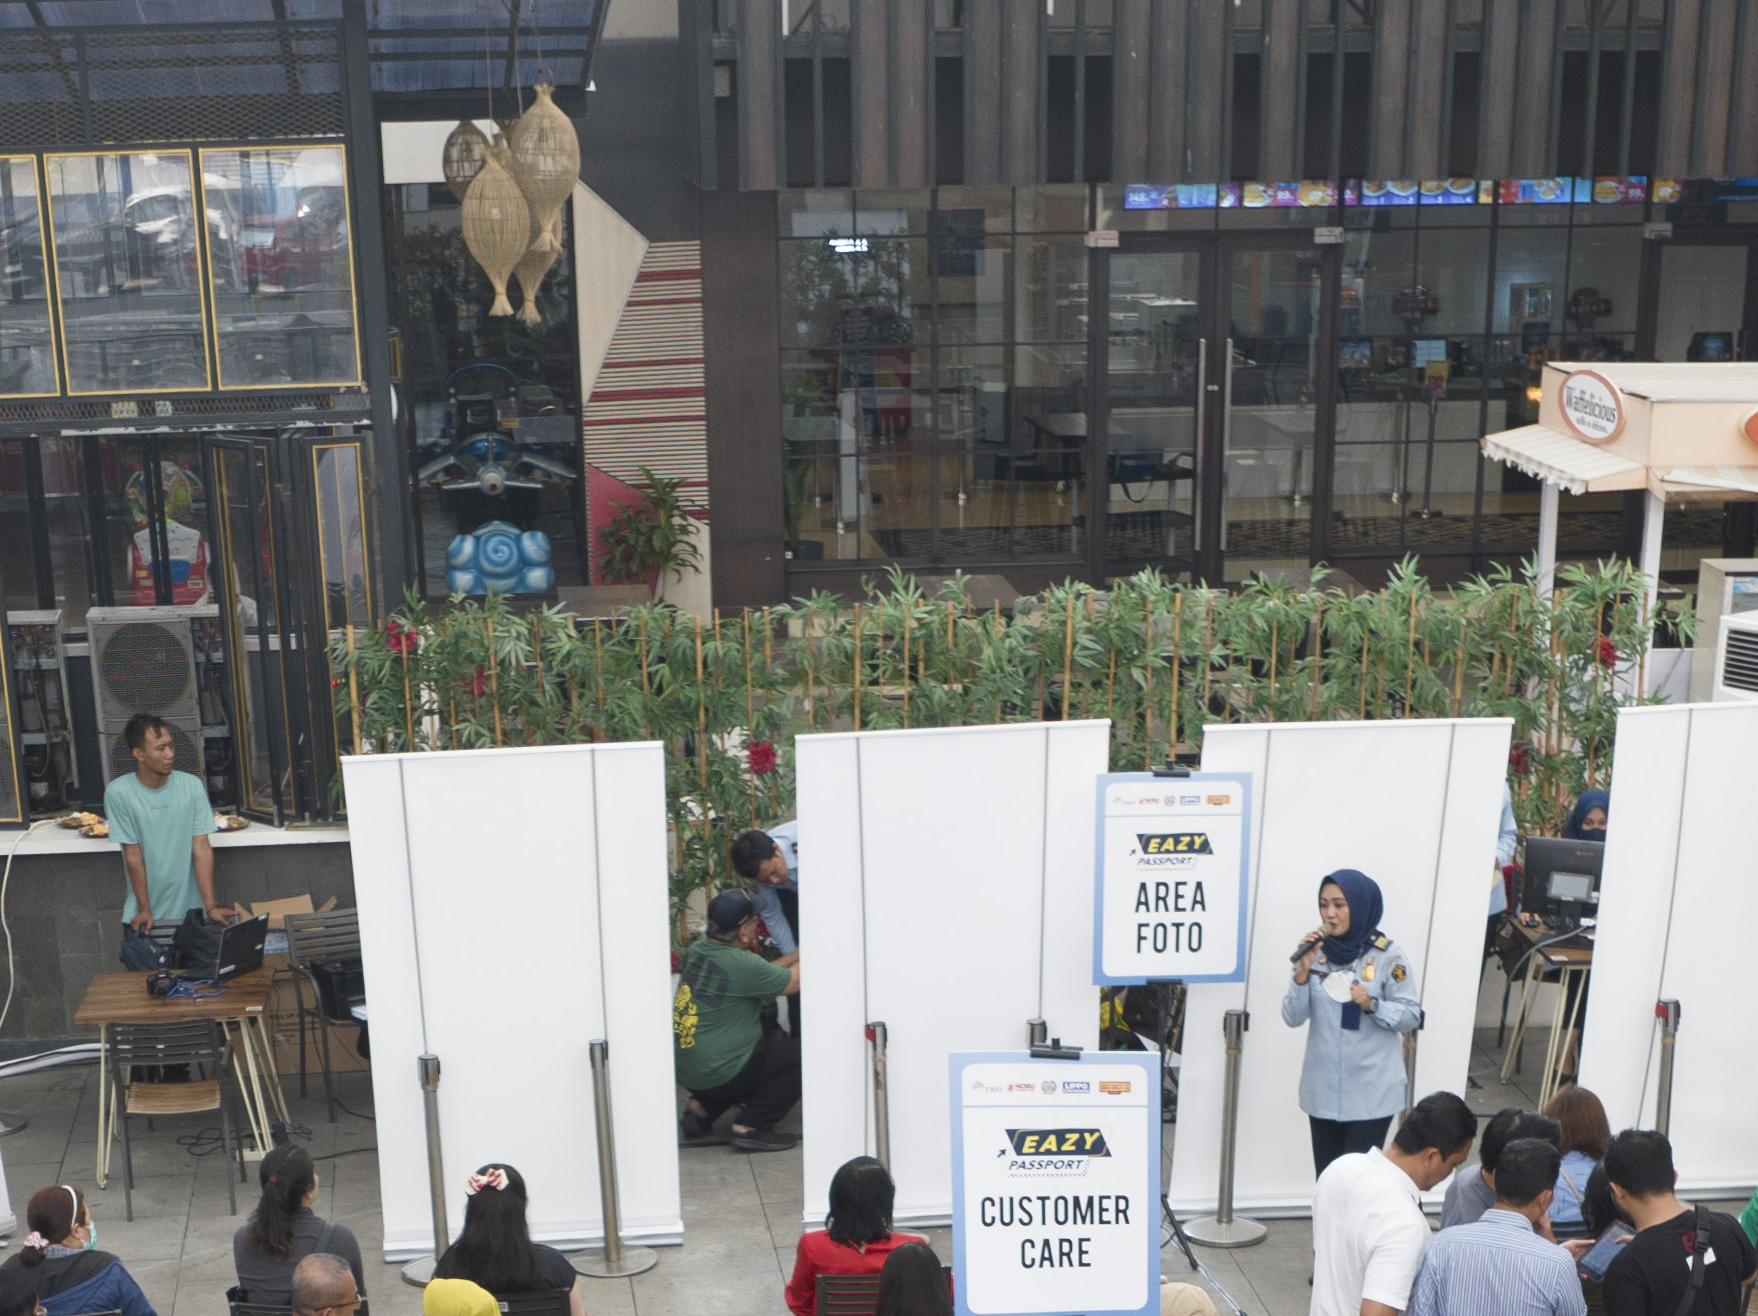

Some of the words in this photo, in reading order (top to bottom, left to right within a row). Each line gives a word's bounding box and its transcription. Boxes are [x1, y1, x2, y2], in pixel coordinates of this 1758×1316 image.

[1147, 835, 1206, 853] EAZY
[1135, 881, 1206, 913] AREA
[1137, 922, 1203, 954] FOTO
[1021, 1131, 1101, 1154] EAZY
[1009, 1159, 1084, 1170] PASSPORT
[981, 1195, 1131, 1227] CUSTOMER
[1020, 1237, 1091, 1269] CARE
